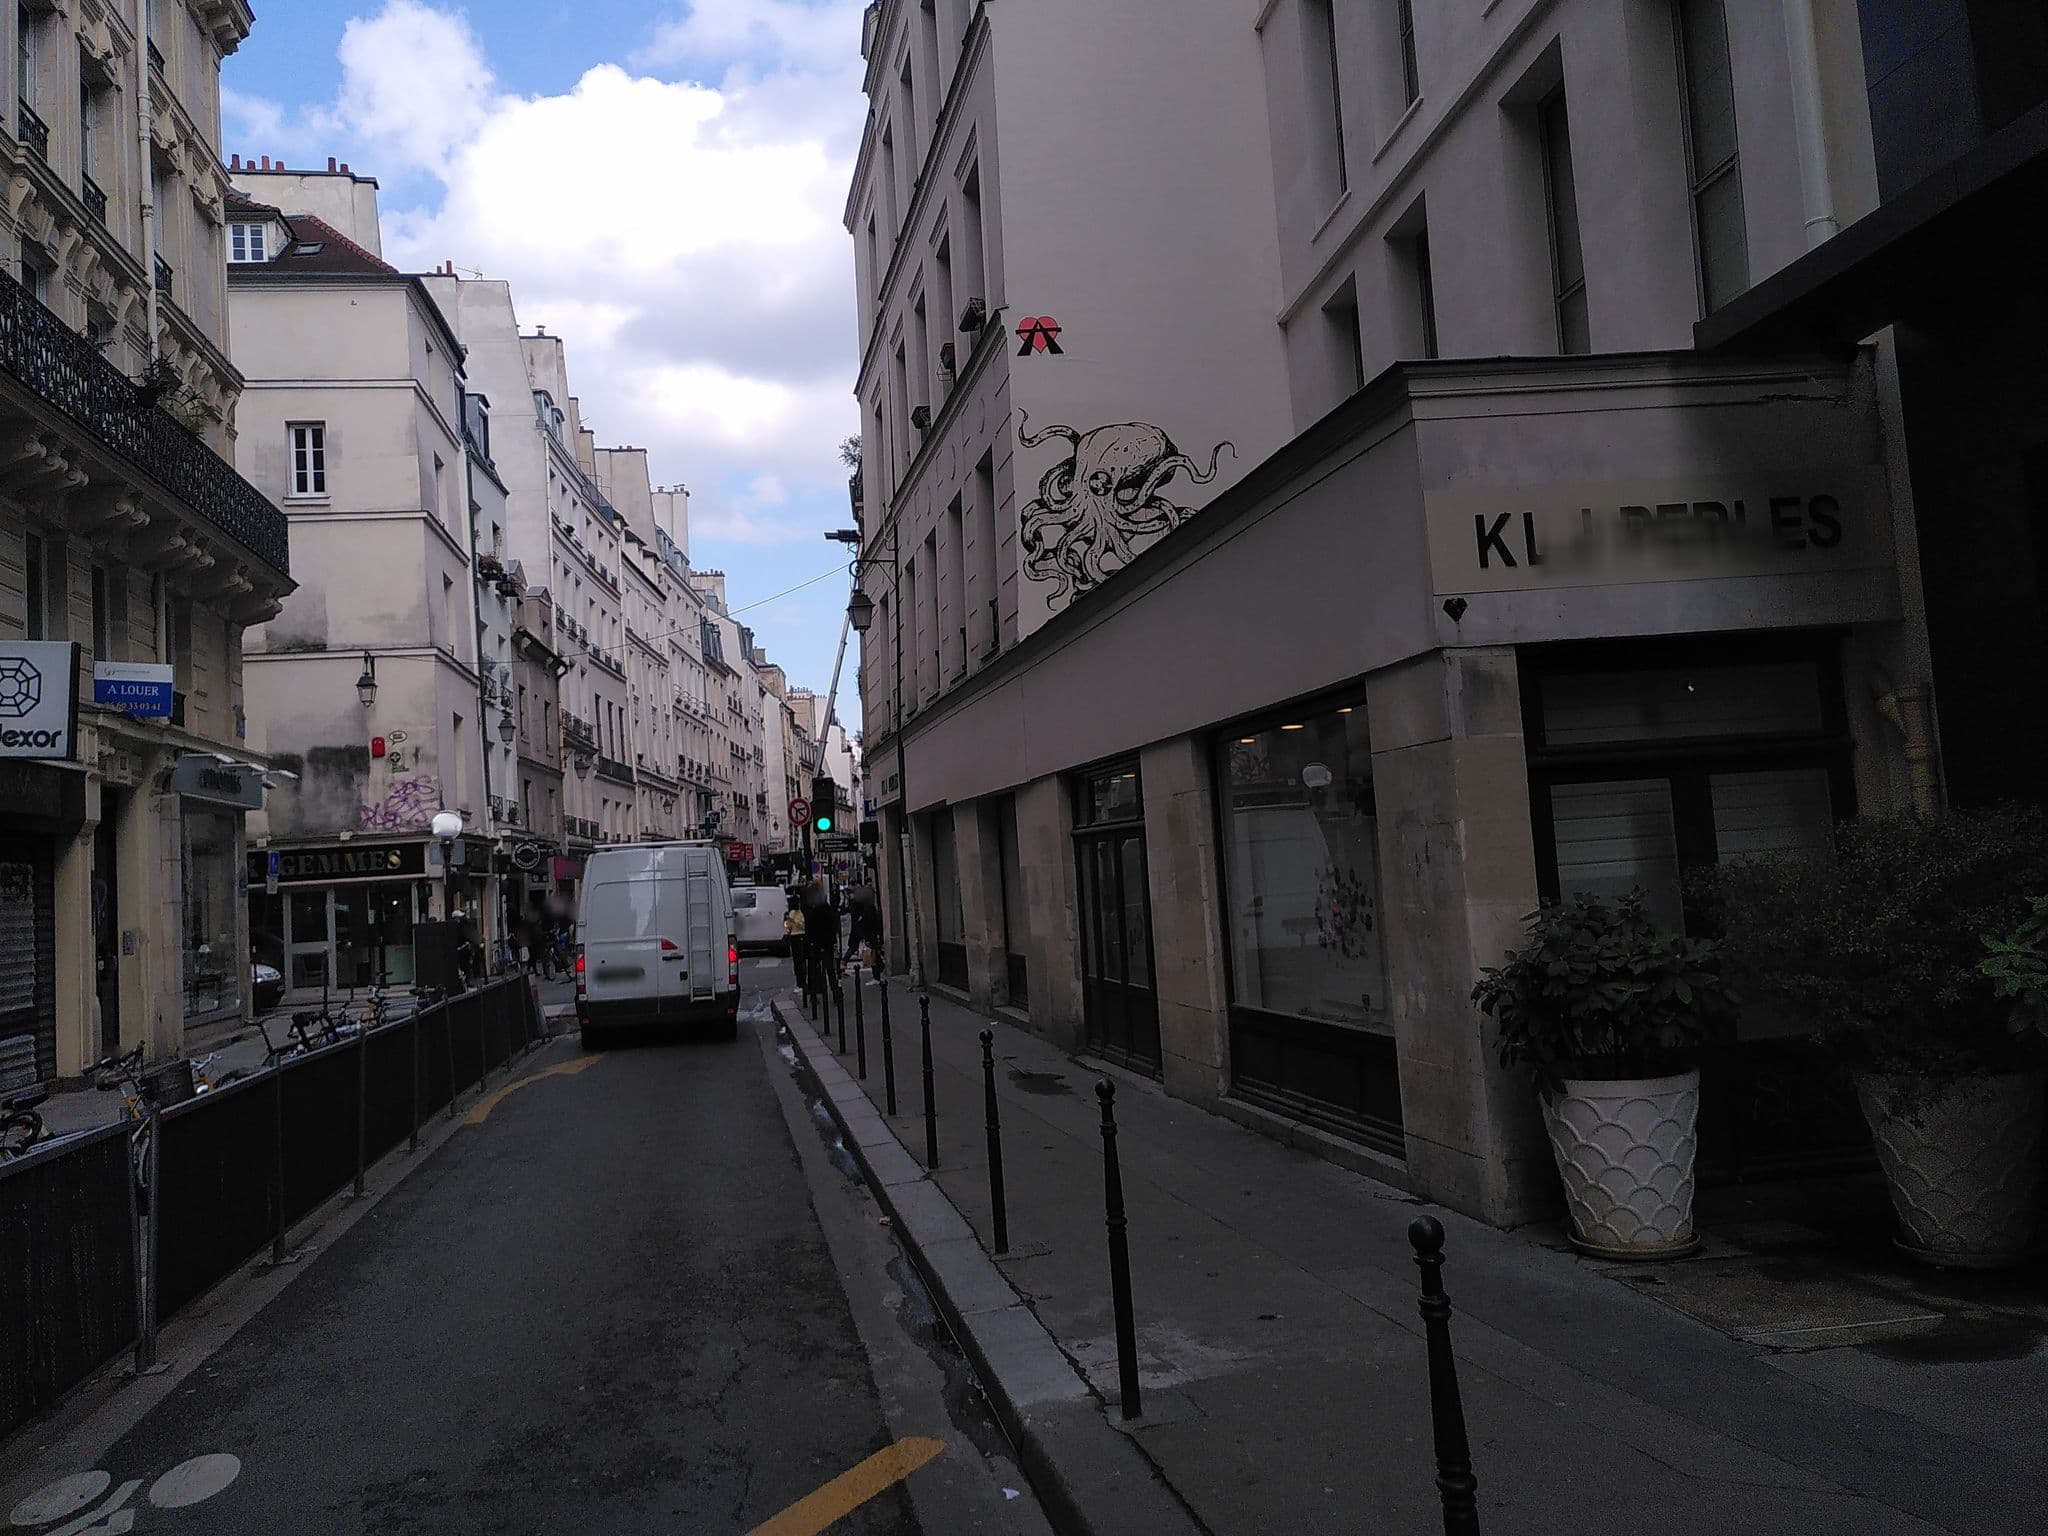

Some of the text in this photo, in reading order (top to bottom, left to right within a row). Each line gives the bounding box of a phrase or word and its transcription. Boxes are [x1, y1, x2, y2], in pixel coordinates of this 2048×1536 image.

[107, 684, 159, 697] A LOUER
[0, 724, 62, 748] exor
[280, 849, 402, 876] GEMMES
